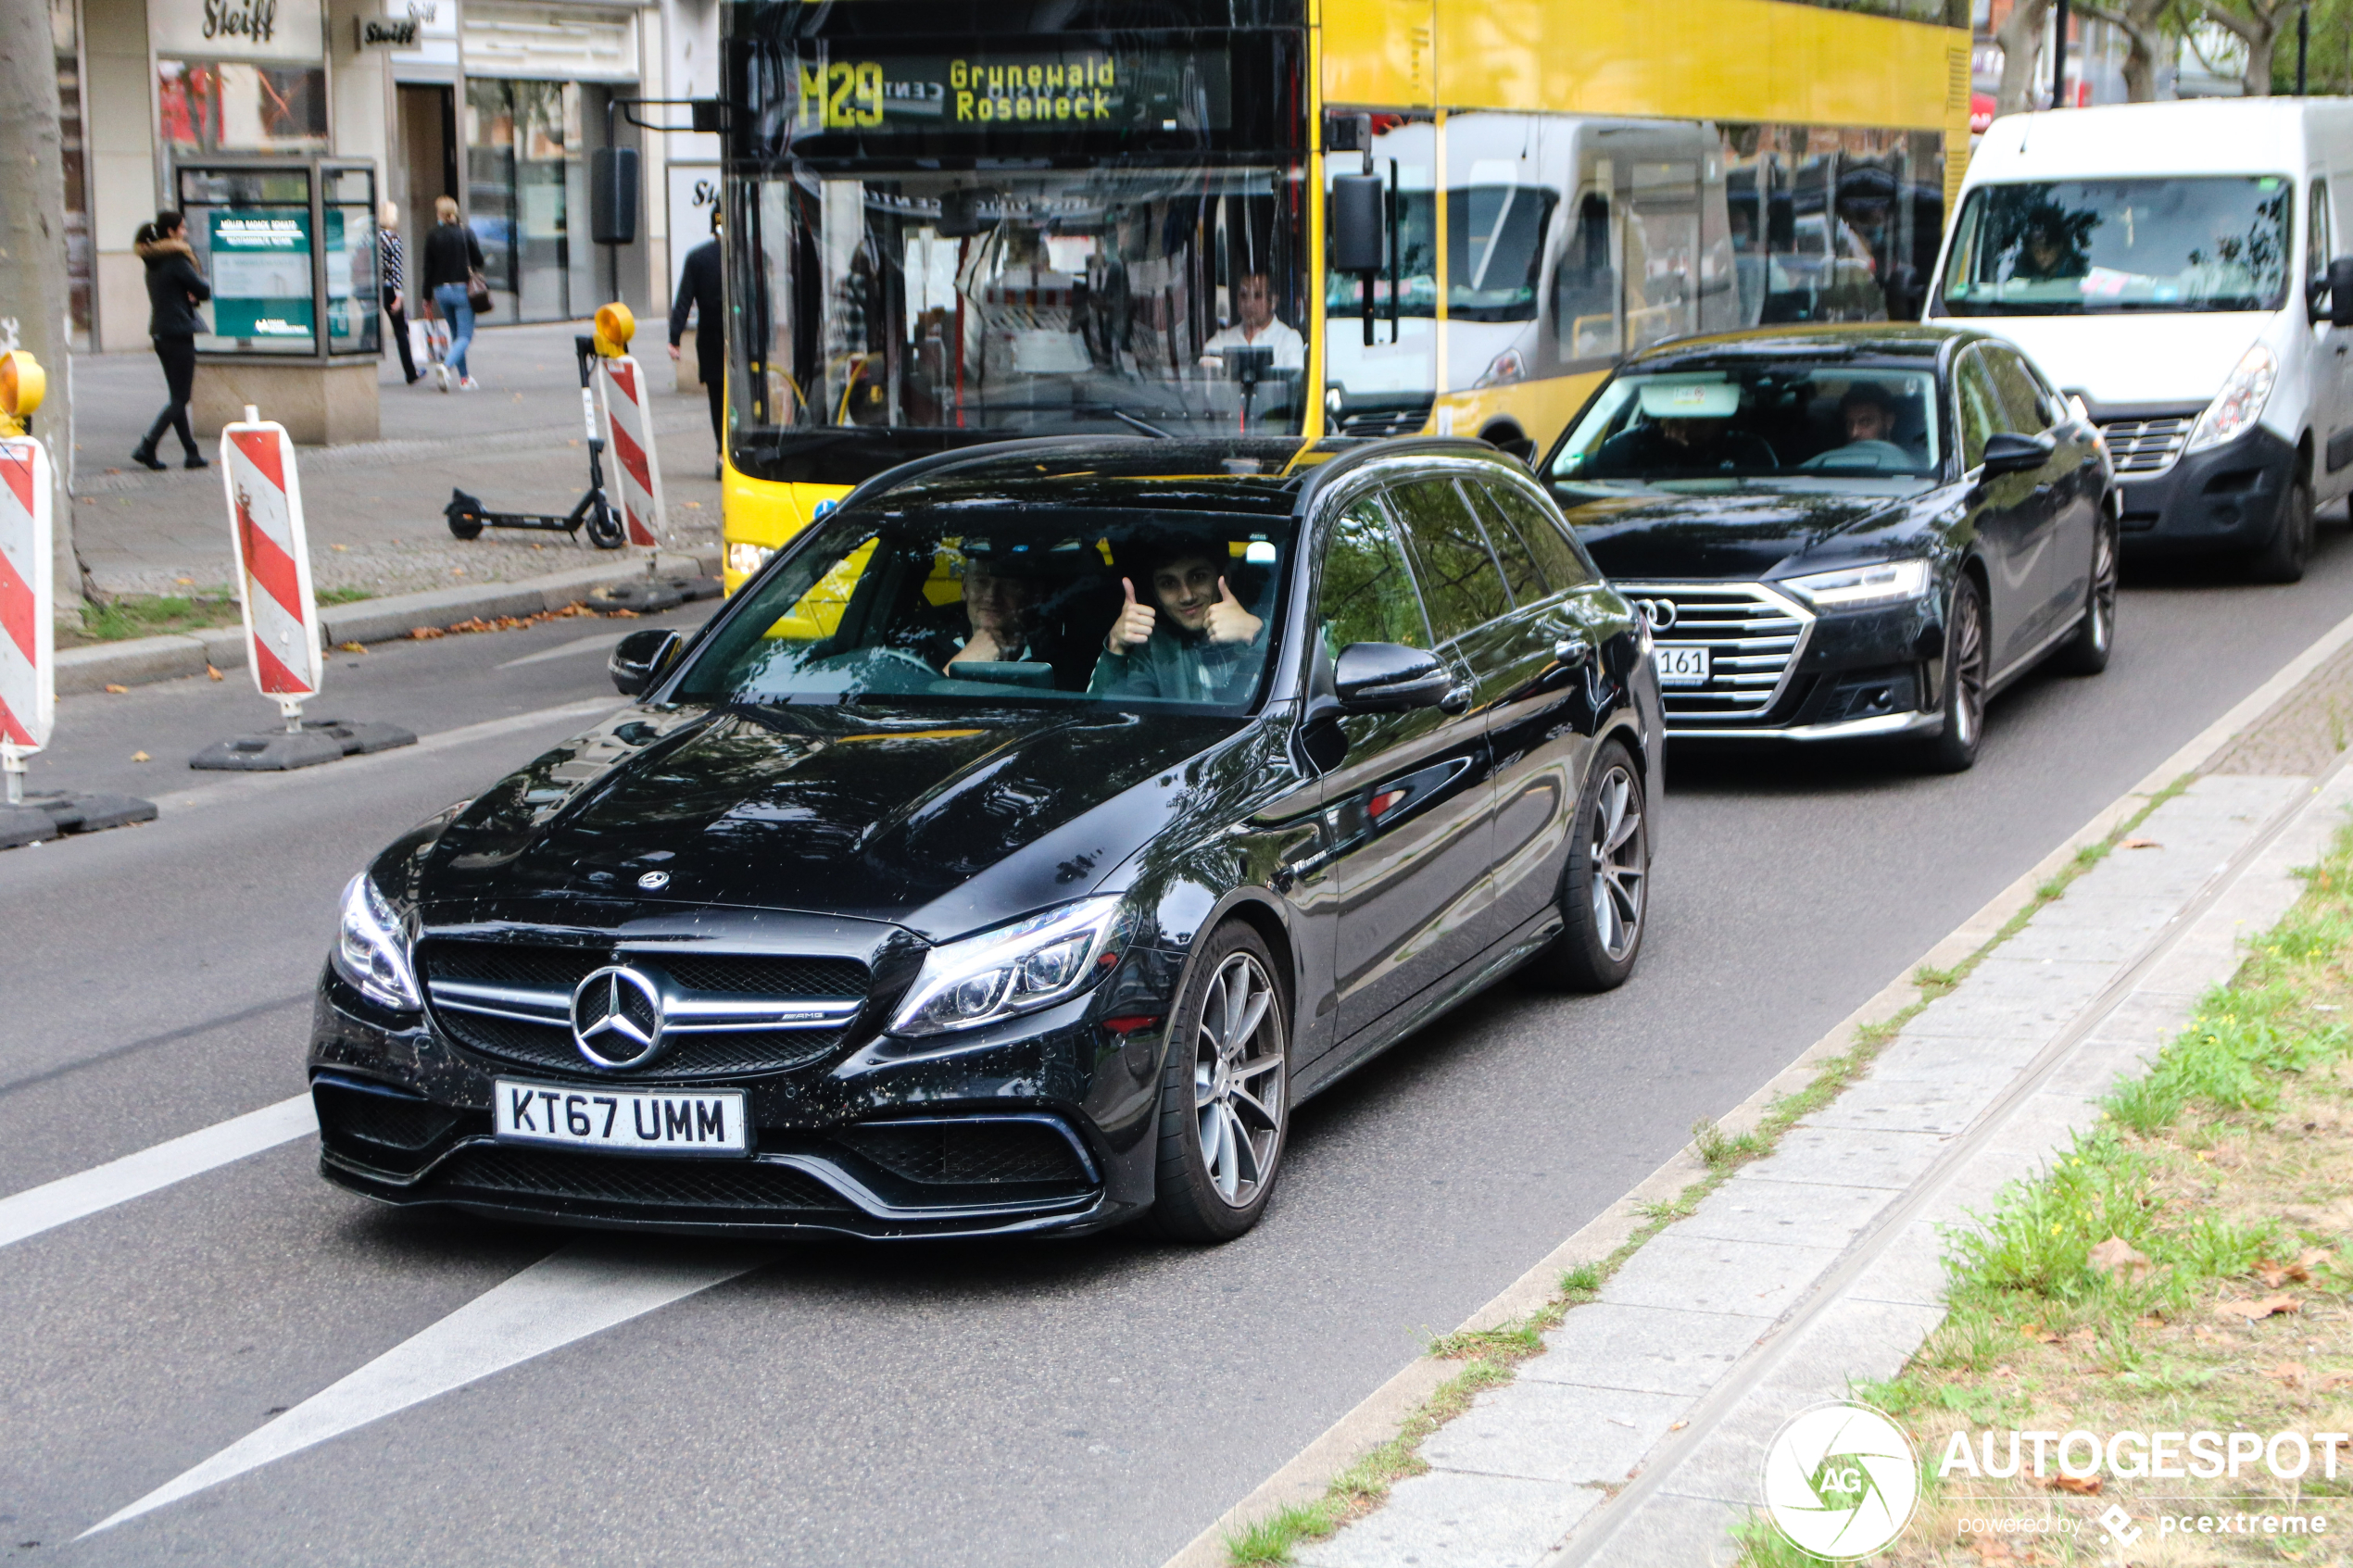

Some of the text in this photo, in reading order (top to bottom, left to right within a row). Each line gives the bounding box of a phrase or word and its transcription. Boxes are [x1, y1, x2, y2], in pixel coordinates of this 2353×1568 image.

[203, 0, 276, 43] Steiff
[364, 20, 416, 44] Steiff
[950, 56, 1114, 90] Grunewald
[799, 61, 882, 128] M29
[956, 89, 1110, 122] Roseneck
[220, 219, 244, 230] MÜLLER
[1660, 650, 1705, 674] 161
[512, 1087, 725, 1143] KT67 UMM
